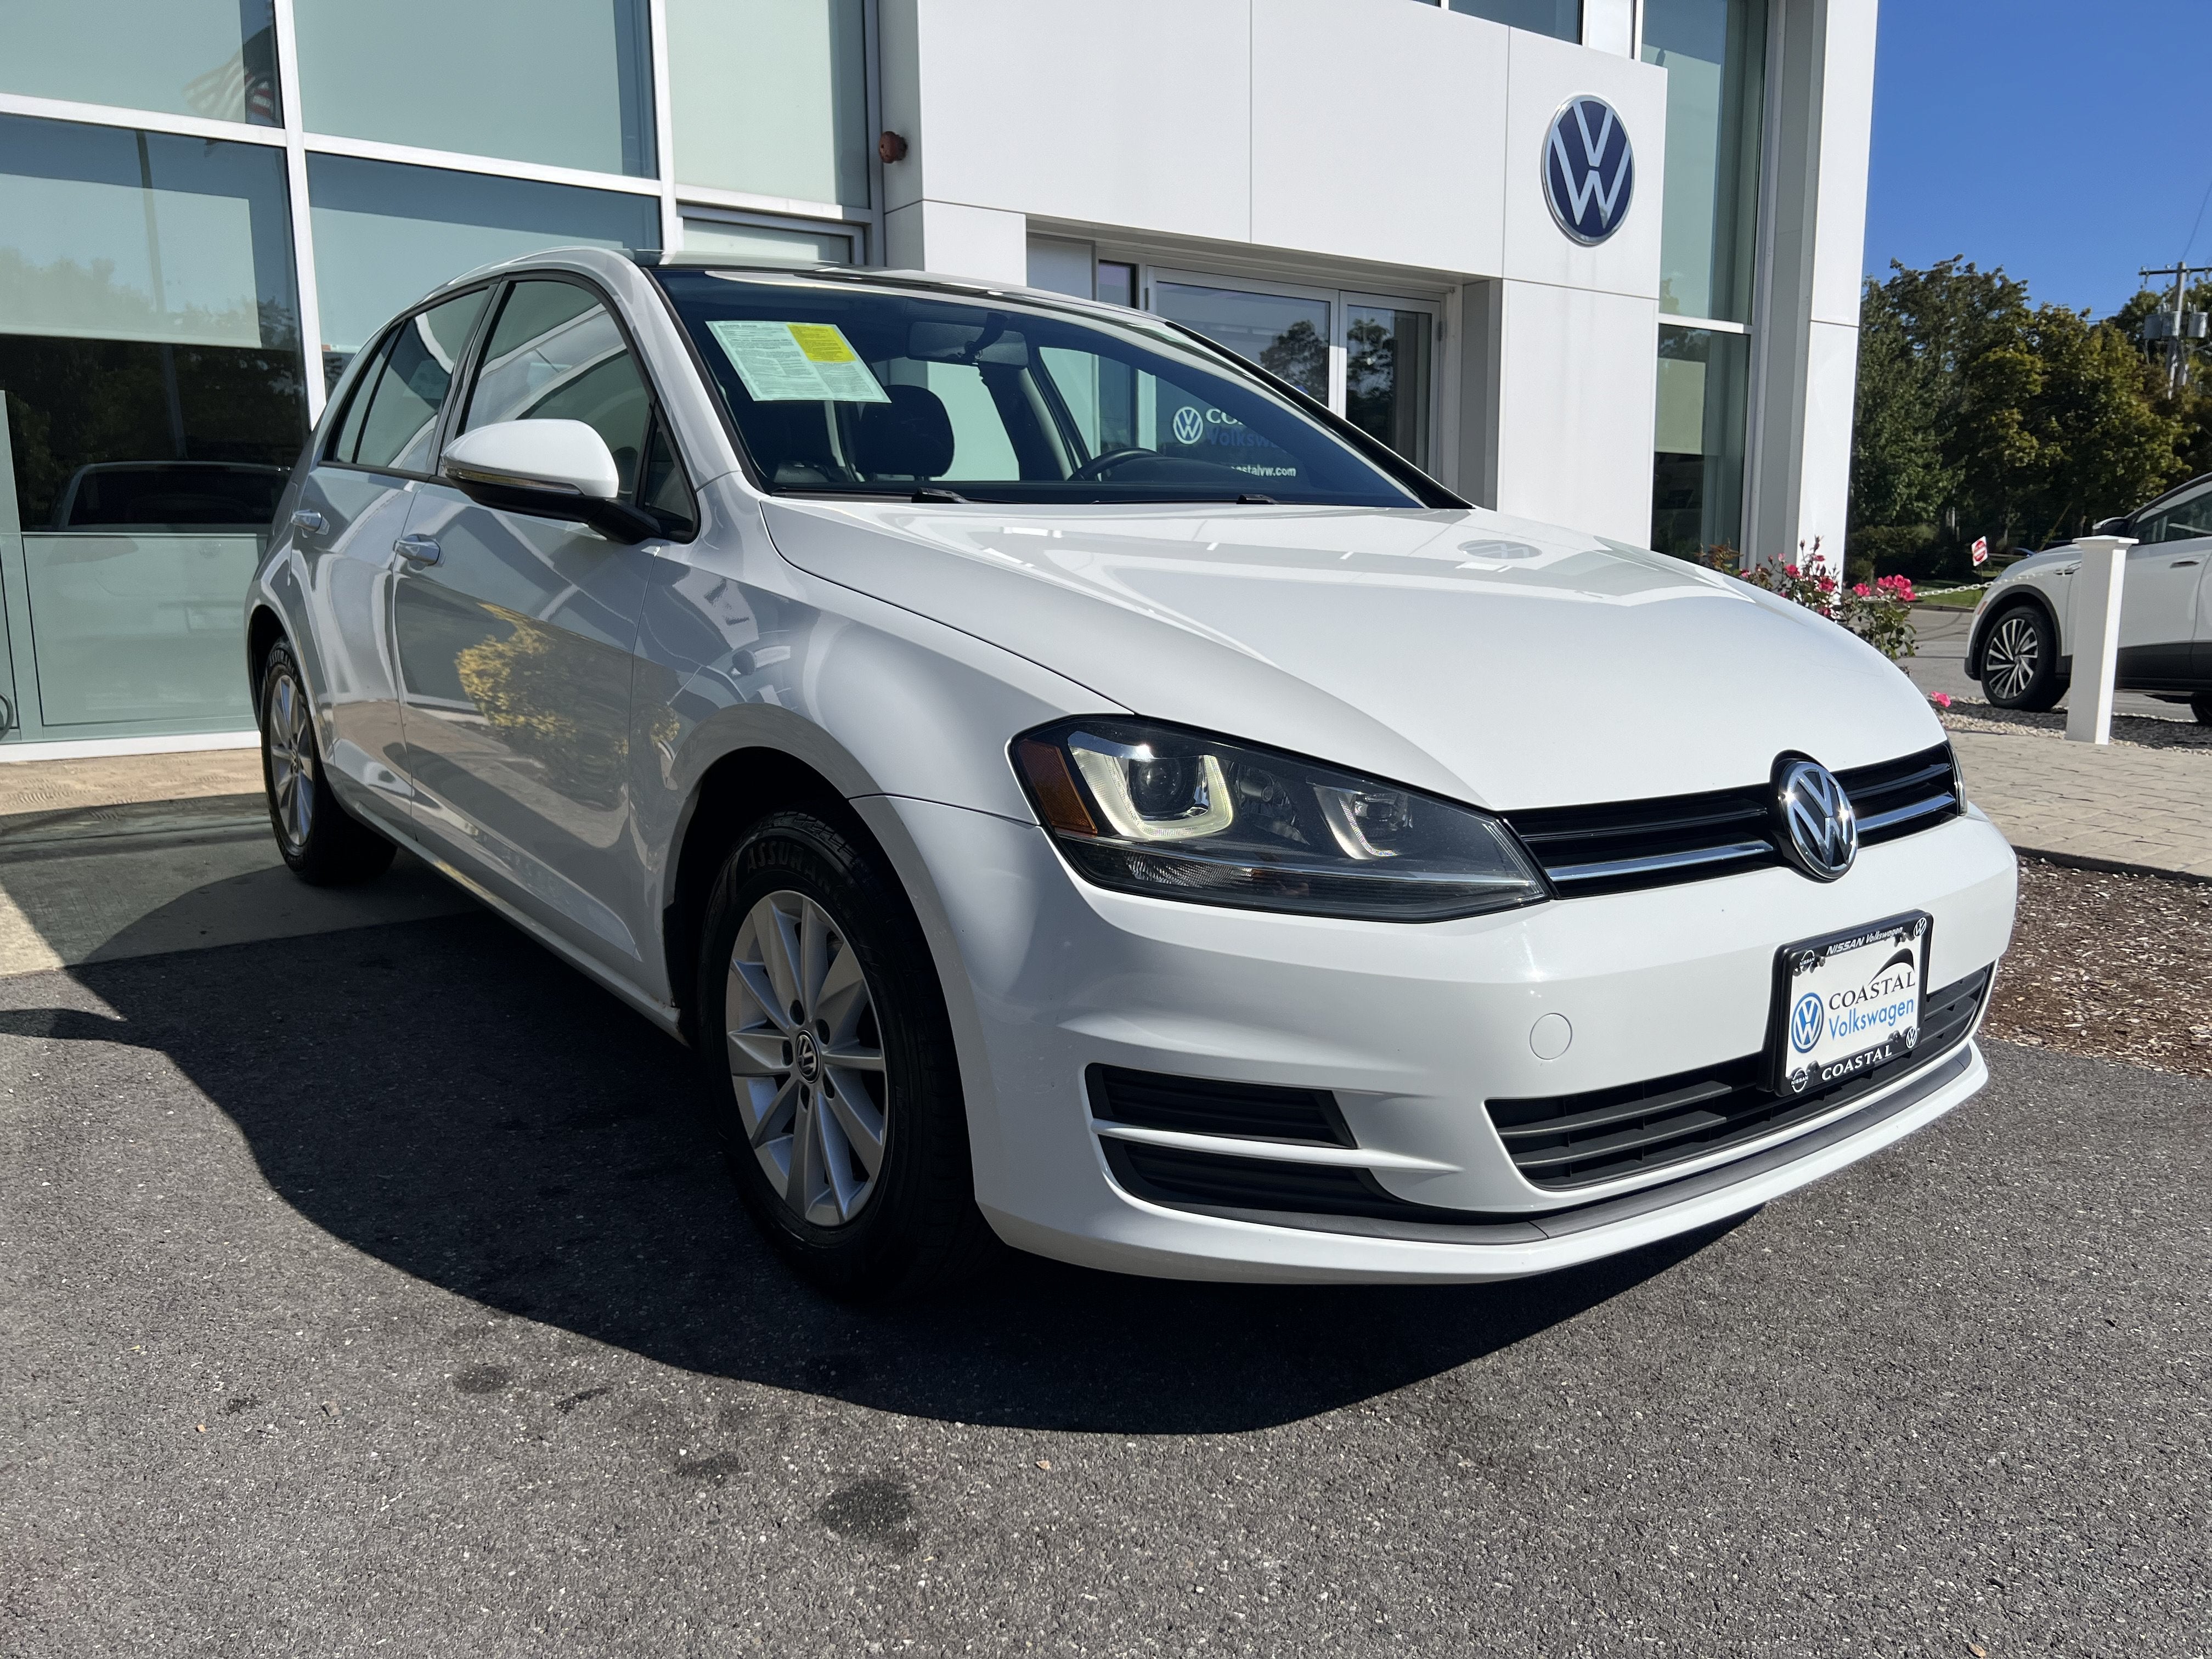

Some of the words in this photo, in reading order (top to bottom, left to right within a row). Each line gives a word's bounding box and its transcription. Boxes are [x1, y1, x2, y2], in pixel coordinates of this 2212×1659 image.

[1547, 99, 1633, 234] VW
[1174, 408, 1202, 442] VW
[1786, 763, 1855, 873] VW
[746, 841, 850, 915] ASSURANC
[1826, 936, 1865, 955] NISSAN
[1866, 927, 1903, 944] Volkswagen
[1799, 957, 1815, 966] NISSAN
[1829, 971, 1915, 1010] COASTAL
[1794, 997, 1822, 1047] VW
[1829, 998, 1914, 1040] Volkswagen
[1791, 1075, 1809, 1085] NISSAN
[1821, 1045, 1892, 1081] COASTAL
